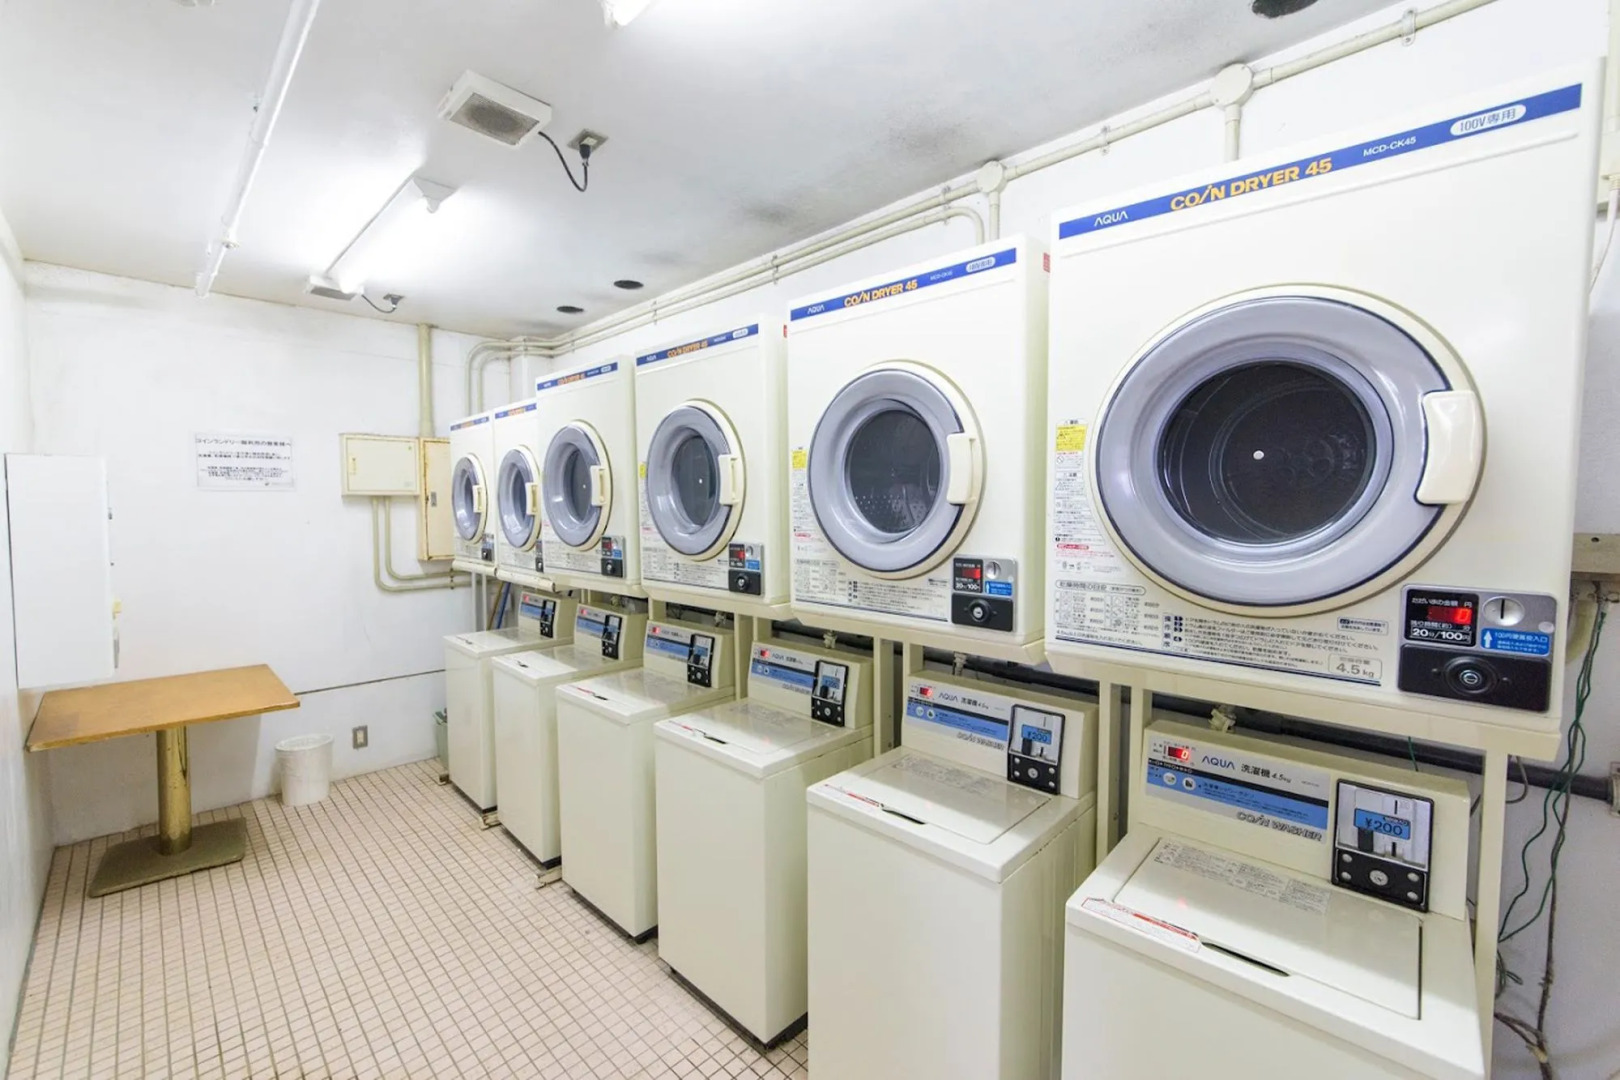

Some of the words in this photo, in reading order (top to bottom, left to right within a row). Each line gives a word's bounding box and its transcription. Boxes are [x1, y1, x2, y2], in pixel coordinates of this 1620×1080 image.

[1363, 136, 1417, 157] MCD-CK45
[1230, 166, 1299, 197] DRYER
[1305, 157, 1332, 176] 45
[1094, 210, 1128, 227] AQUA
[872, 283, 904, 300] DRYER
[905, 279, 918, 291] 45
[1457, 608, 1471, 623] 0
[1202, 755, 1235, 770] AQUA
[1241, 763, 1270, 779] 洗濯機
[1365, 817, 1403, 836] ¥200
